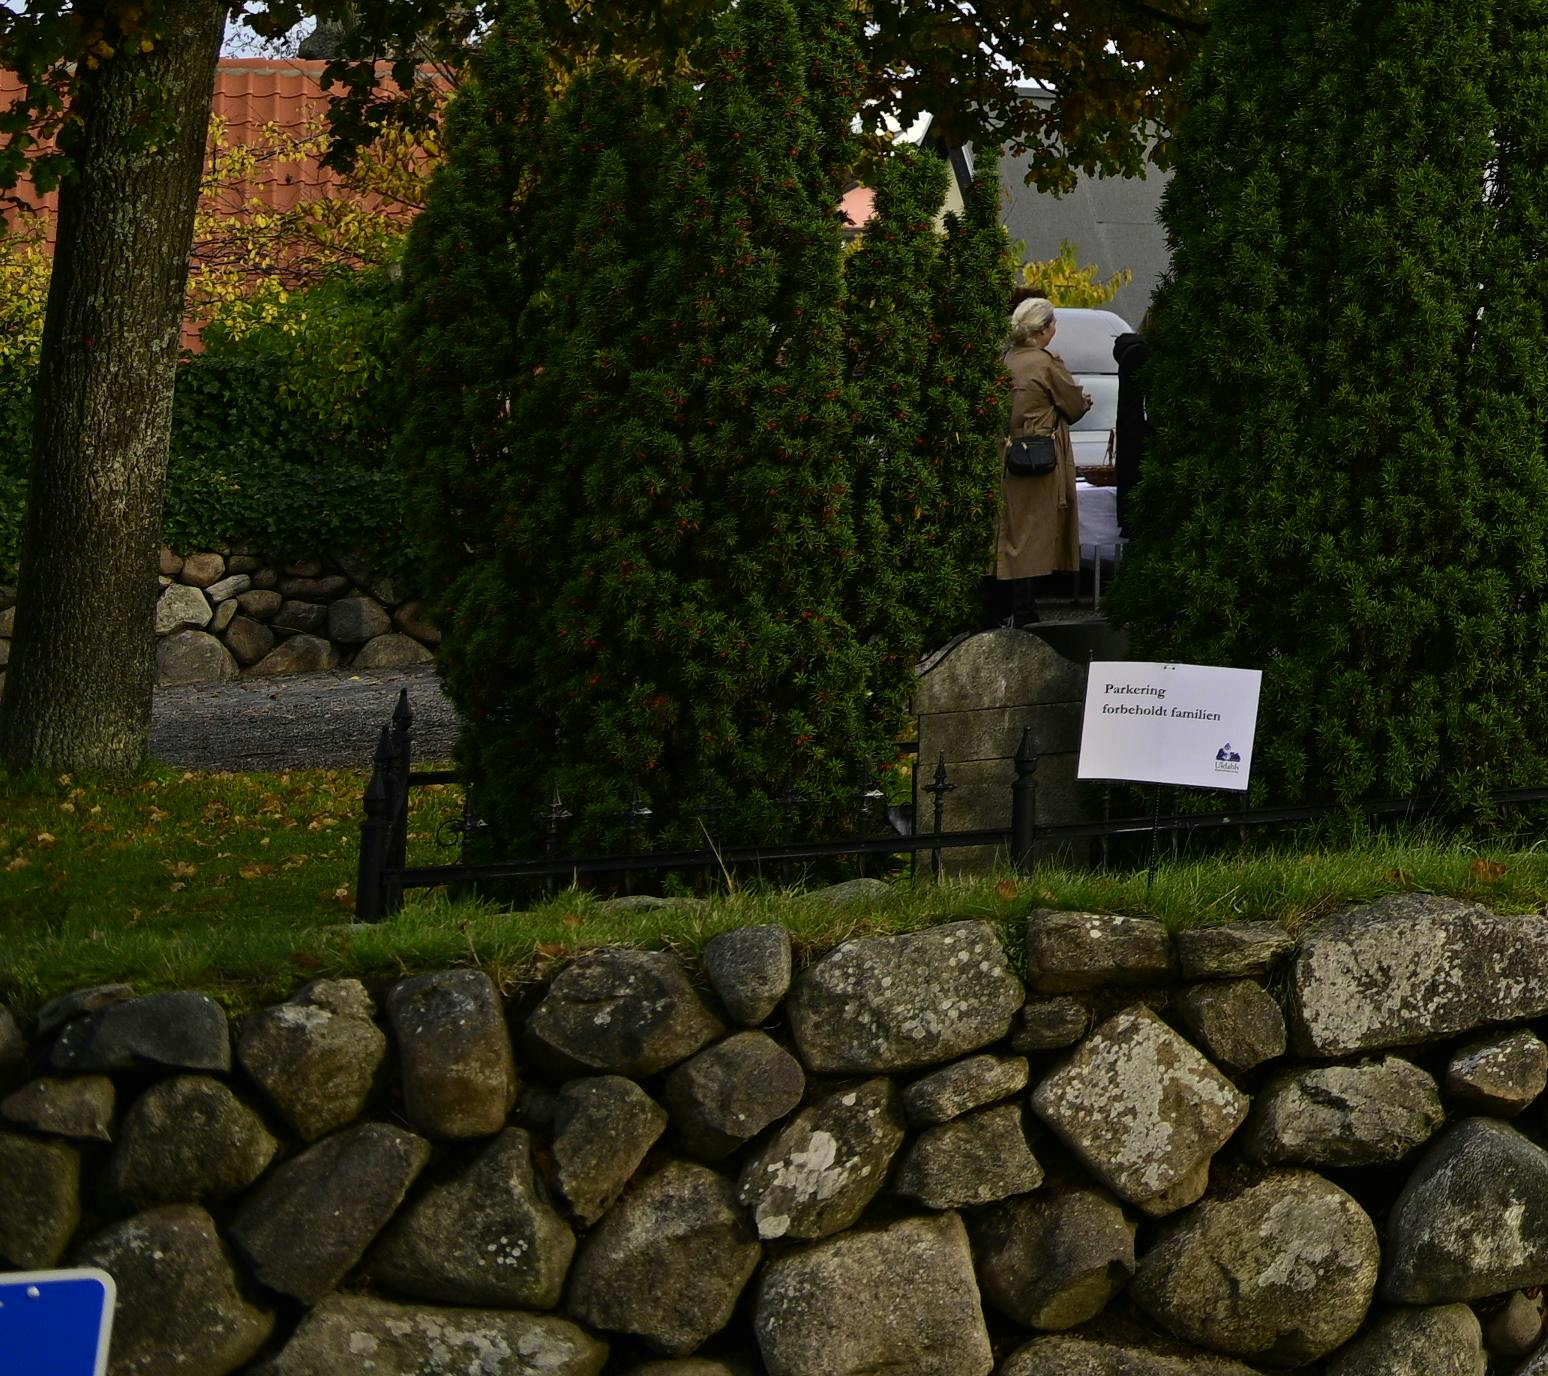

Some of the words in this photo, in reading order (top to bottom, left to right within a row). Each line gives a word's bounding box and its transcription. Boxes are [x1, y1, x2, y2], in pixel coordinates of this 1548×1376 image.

[1104, 683, 1167, 699] Parkering
[1102, 704, 1167, 717] forbeholdt
[1170, 707, 1221, 722] familien
